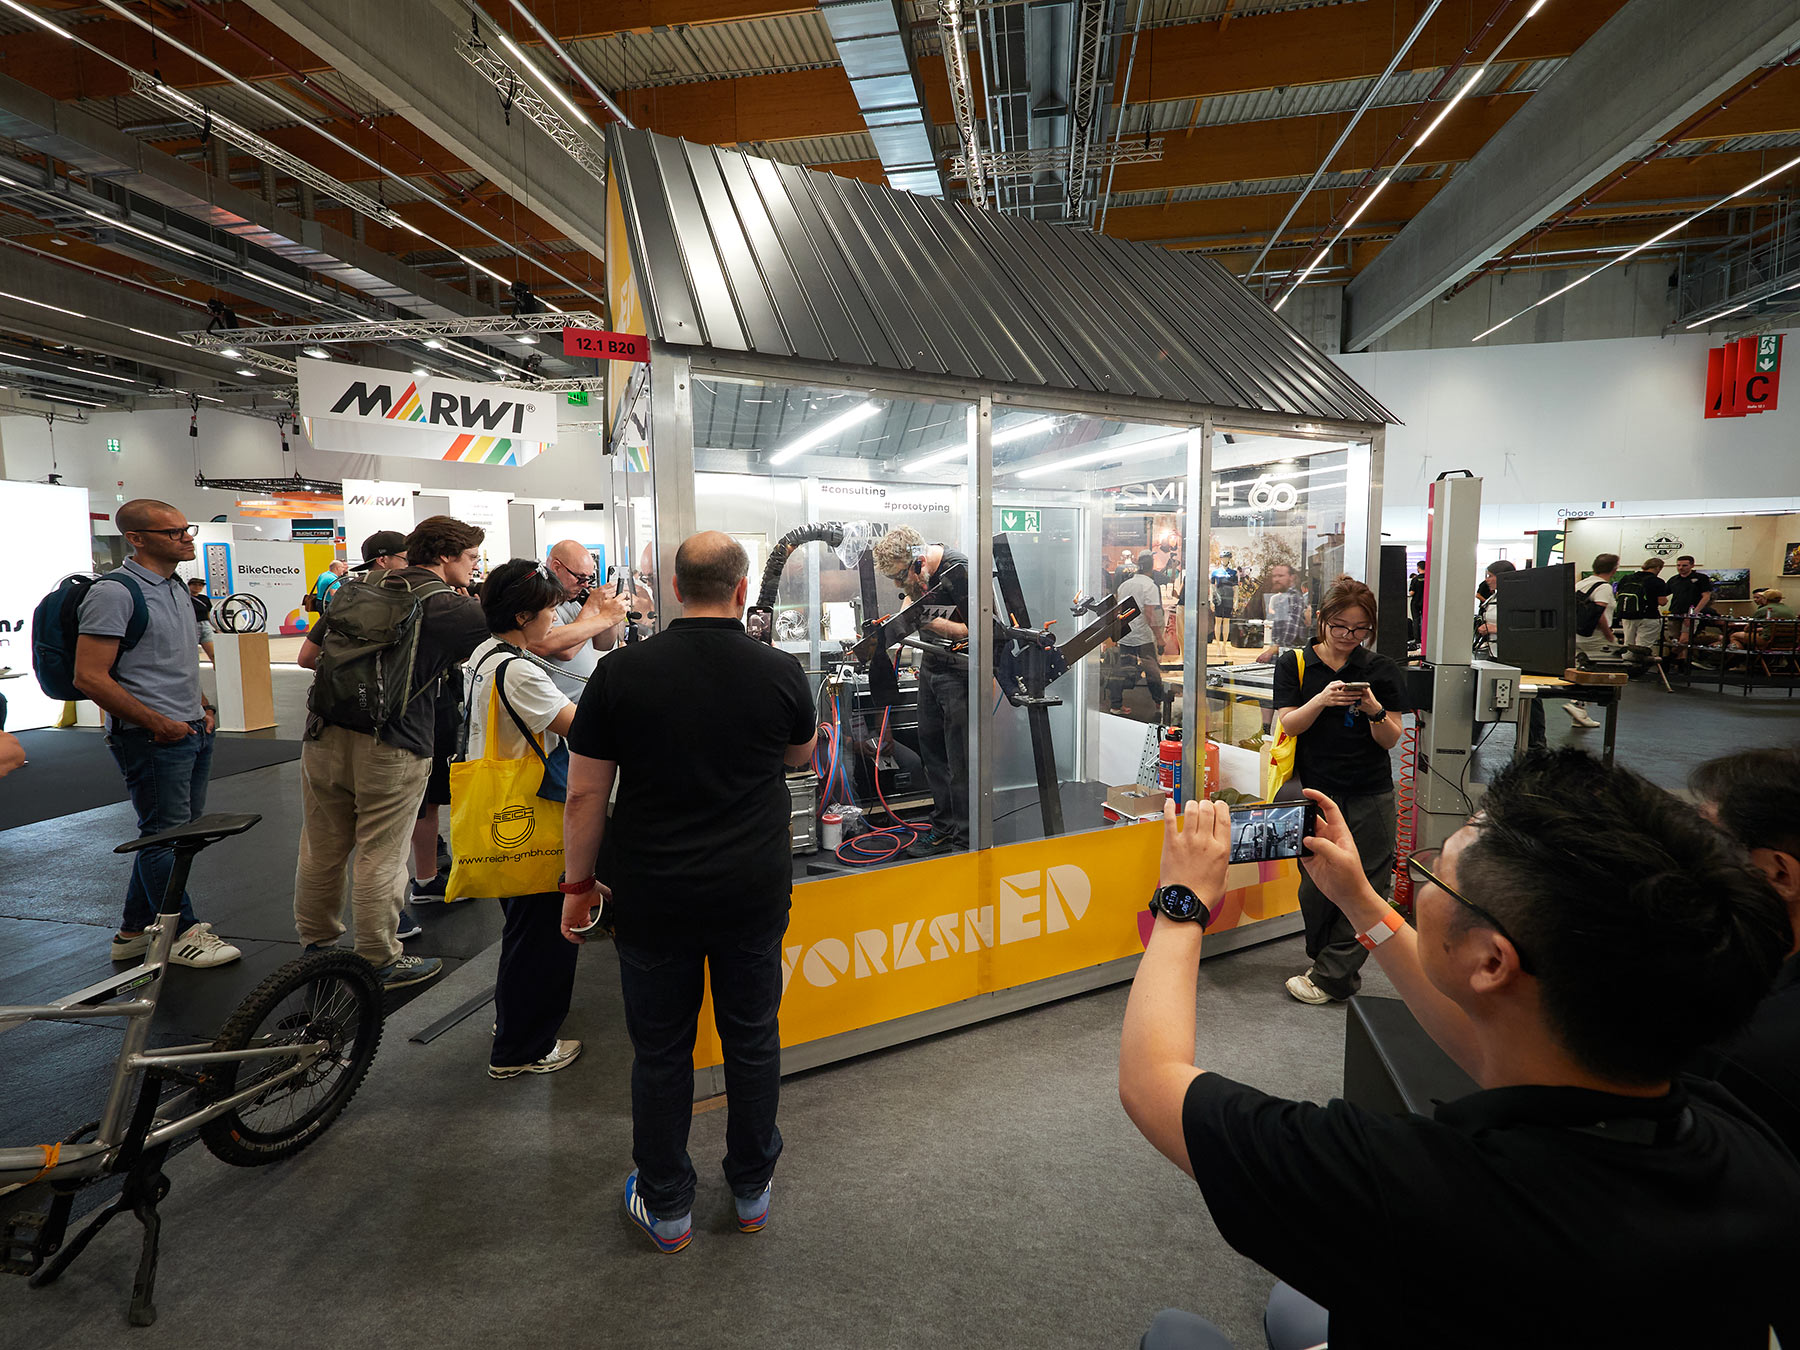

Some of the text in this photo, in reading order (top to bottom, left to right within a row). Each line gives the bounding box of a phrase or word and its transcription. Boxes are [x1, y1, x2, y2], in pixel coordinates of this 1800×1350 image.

[576, 338, 636, 355] 12.1 B20
[1746, 375, 1769, 403] C
[821, 485, 886, 498] #consulting
[884, 502, 950, 513] #prototyping
[1557, 508, 1595, 517] Choose
[493, 808, 535, 822] REICH
[458, 847, 566, 866] www.reich-gmbh.com
